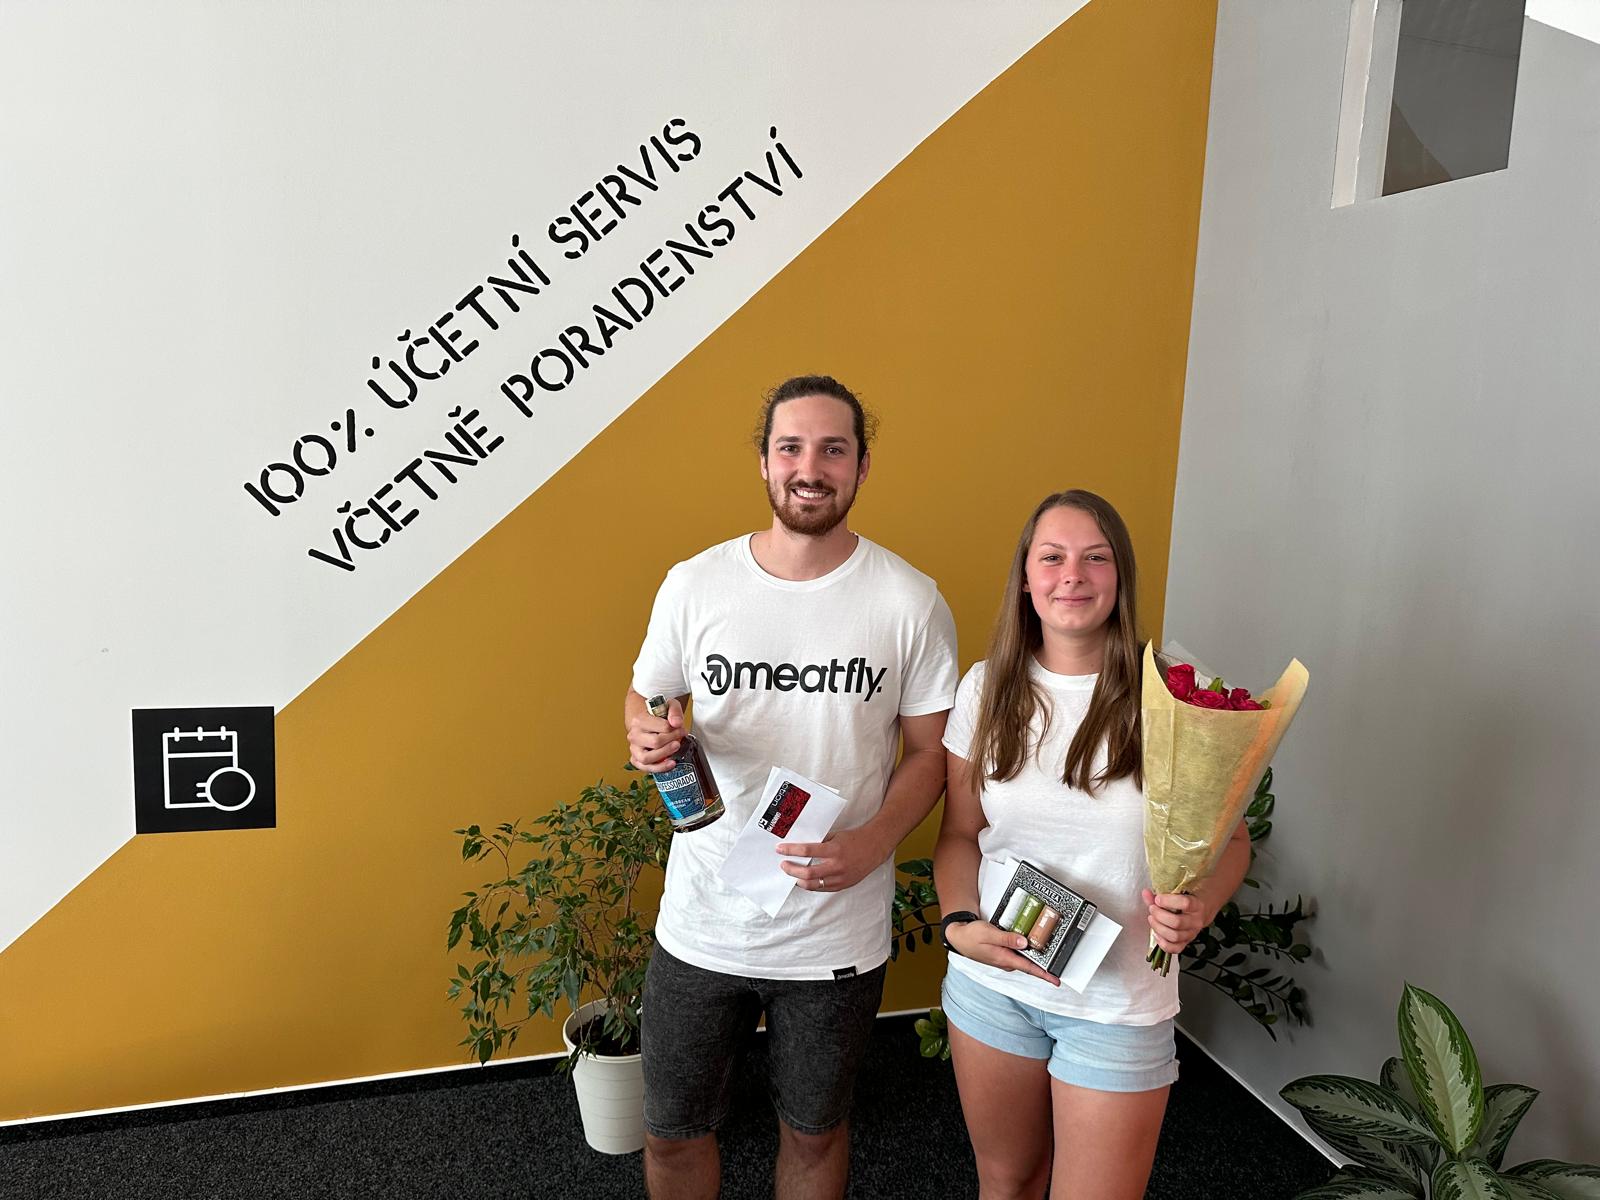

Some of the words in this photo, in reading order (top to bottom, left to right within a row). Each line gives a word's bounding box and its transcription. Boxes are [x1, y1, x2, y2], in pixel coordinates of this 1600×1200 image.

[244, 408, 375, 516] 100%
[367, 234, 551, 409] ÚČETNÍ
[548, 118, 702, 260] SERVIS
[308, 406, 505, 572] VČETNĚ
[501, 126, 803, 417] PORADENSTVÍ
